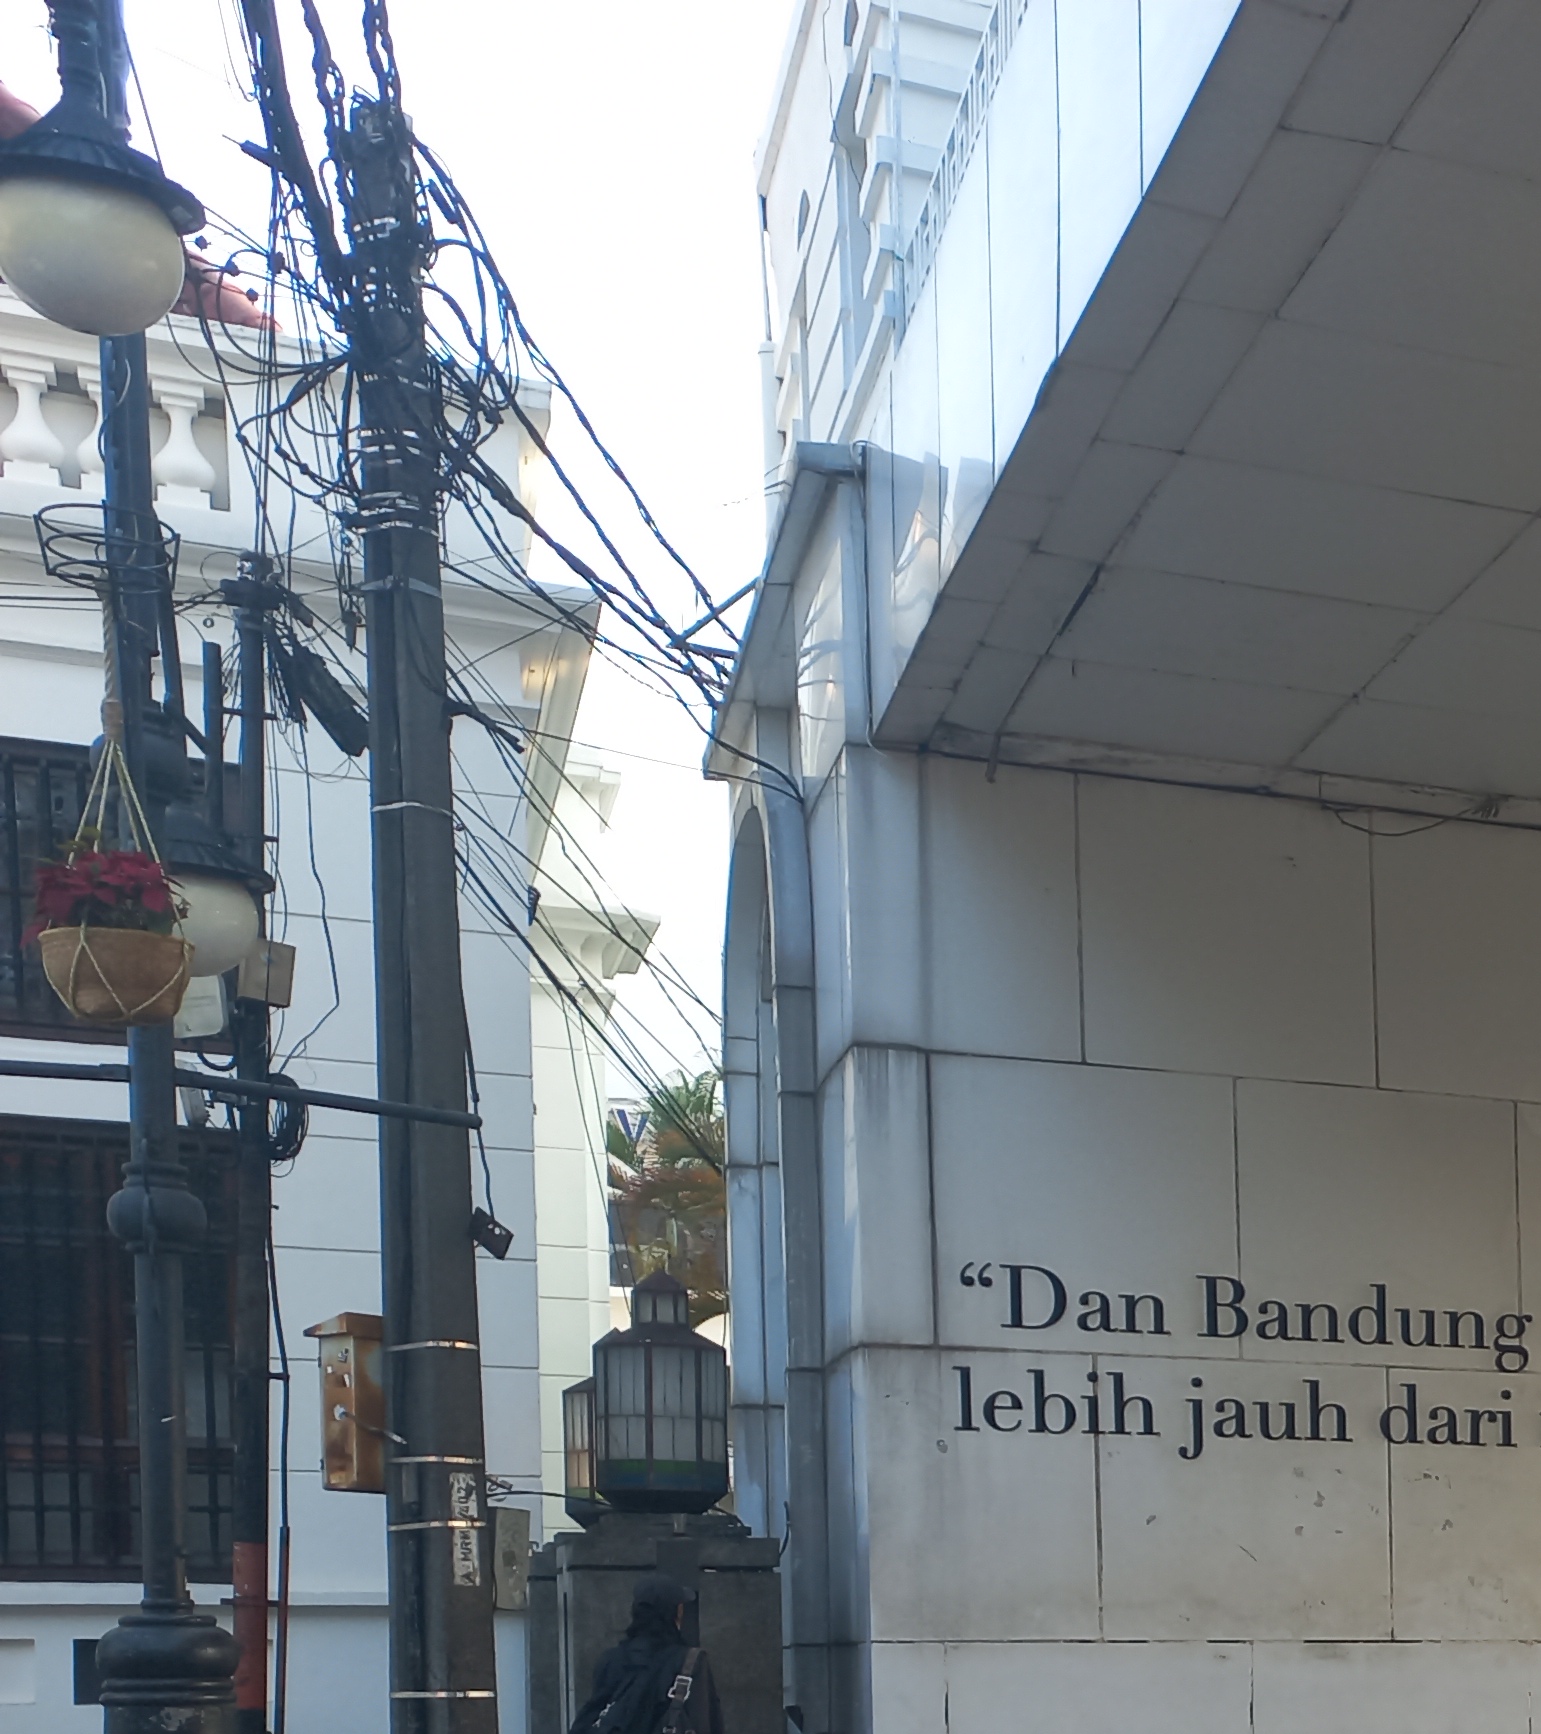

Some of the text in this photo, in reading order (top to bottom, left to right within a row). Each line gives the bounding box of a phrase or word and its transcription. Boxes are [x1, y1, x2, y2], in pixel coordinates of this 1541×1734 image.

[1196, 1274, 1533, 1374] Bandung
[952, 1367, 1160, 1438] lebih
[1179, 1376, 1352, 1459] jauh
[1379, 1383, 1517, 1447] dari
